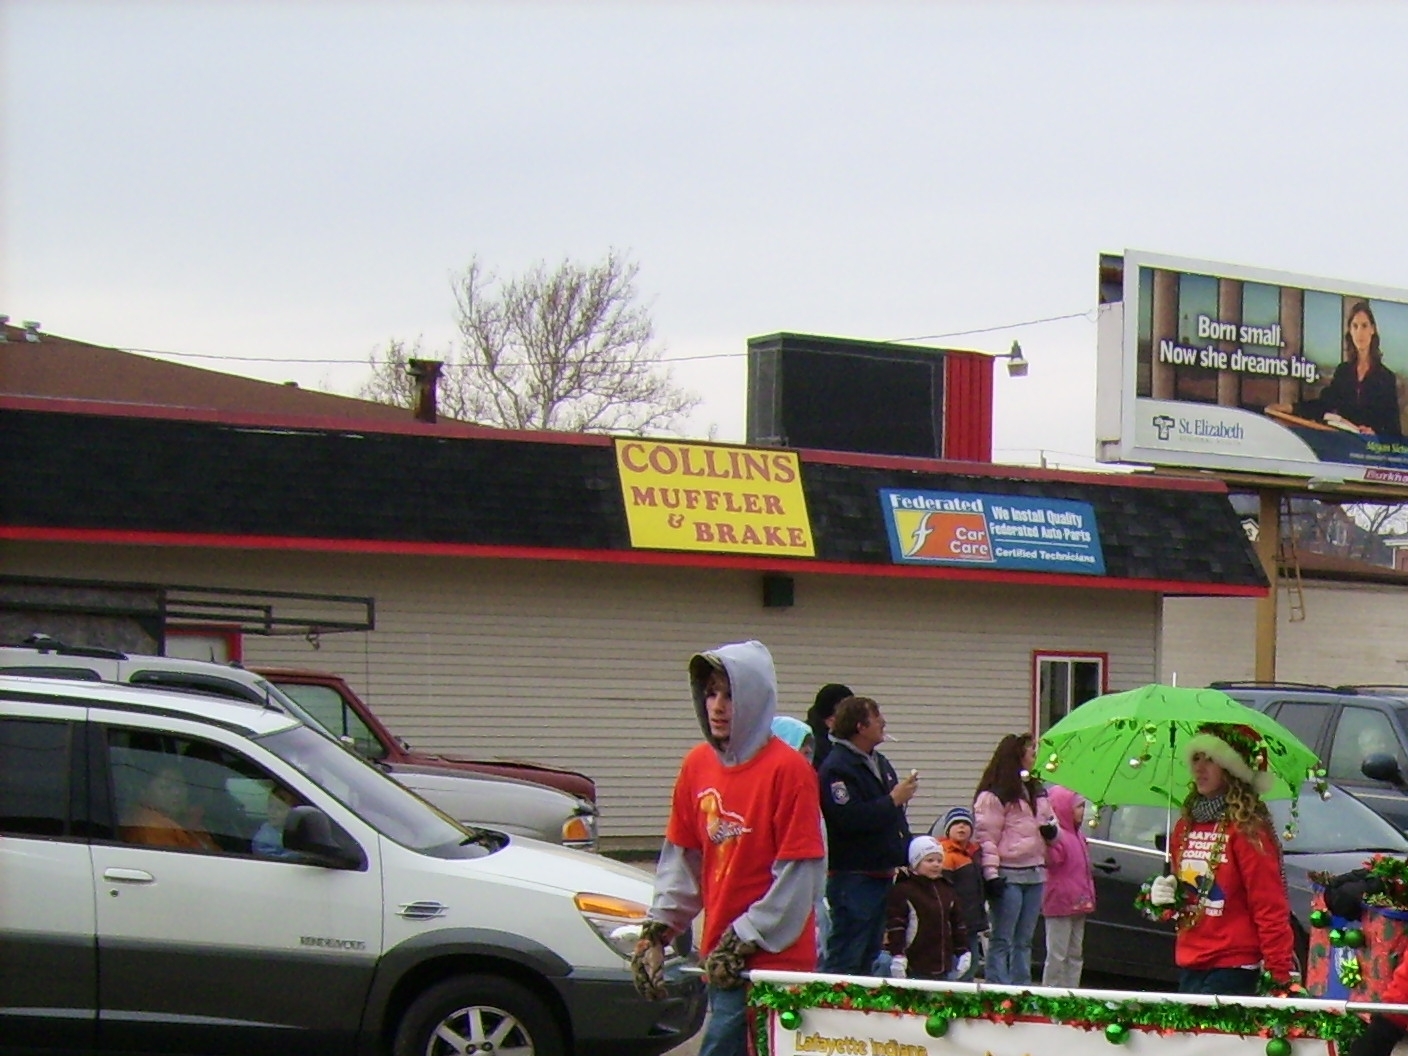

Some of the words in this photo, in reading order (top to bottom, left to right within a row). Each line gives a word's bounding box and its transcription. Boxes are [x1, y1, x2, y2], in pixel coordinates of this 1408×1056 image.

[1198, 315, 1237, 341] Born
[1240, 324, 1285, 347] small.
[1160, 340, 1197, 365] Now
[1200, 345, 1228, 369] she
[1231, 349, 1288, 376] dreams
[1291, 356, 1320, 383] big.
[1195, 419, 1244, 439] Elizabeth
[621, 444, 795, 483] COLLINS
[631, 486, 785, 515] MUFFLER
[889, 494, 985, 512] Federated
[991, 506, 1010, 521] We
[1011, 506, 1045, 524] Install
[1047, 510, 1083, 528] Quality
[667, 513, 685, 529] &
[693, 522, 807, 548] BRAKE
[956, 527, 985, 541] Car
[989, 522, 1039, 538] Federated
[1041, 526, 1063, 539] Auto
[1063, 528, 1091, 542] Parts
[950, 540, 988, 555] Care
[995, 548, 1037, 559] Certified
[1040, 551, 1095, 563] Technicians
[1182, 849, 1229, 863] COUNL
[795, 1030, 868, 1056] Lafayette
